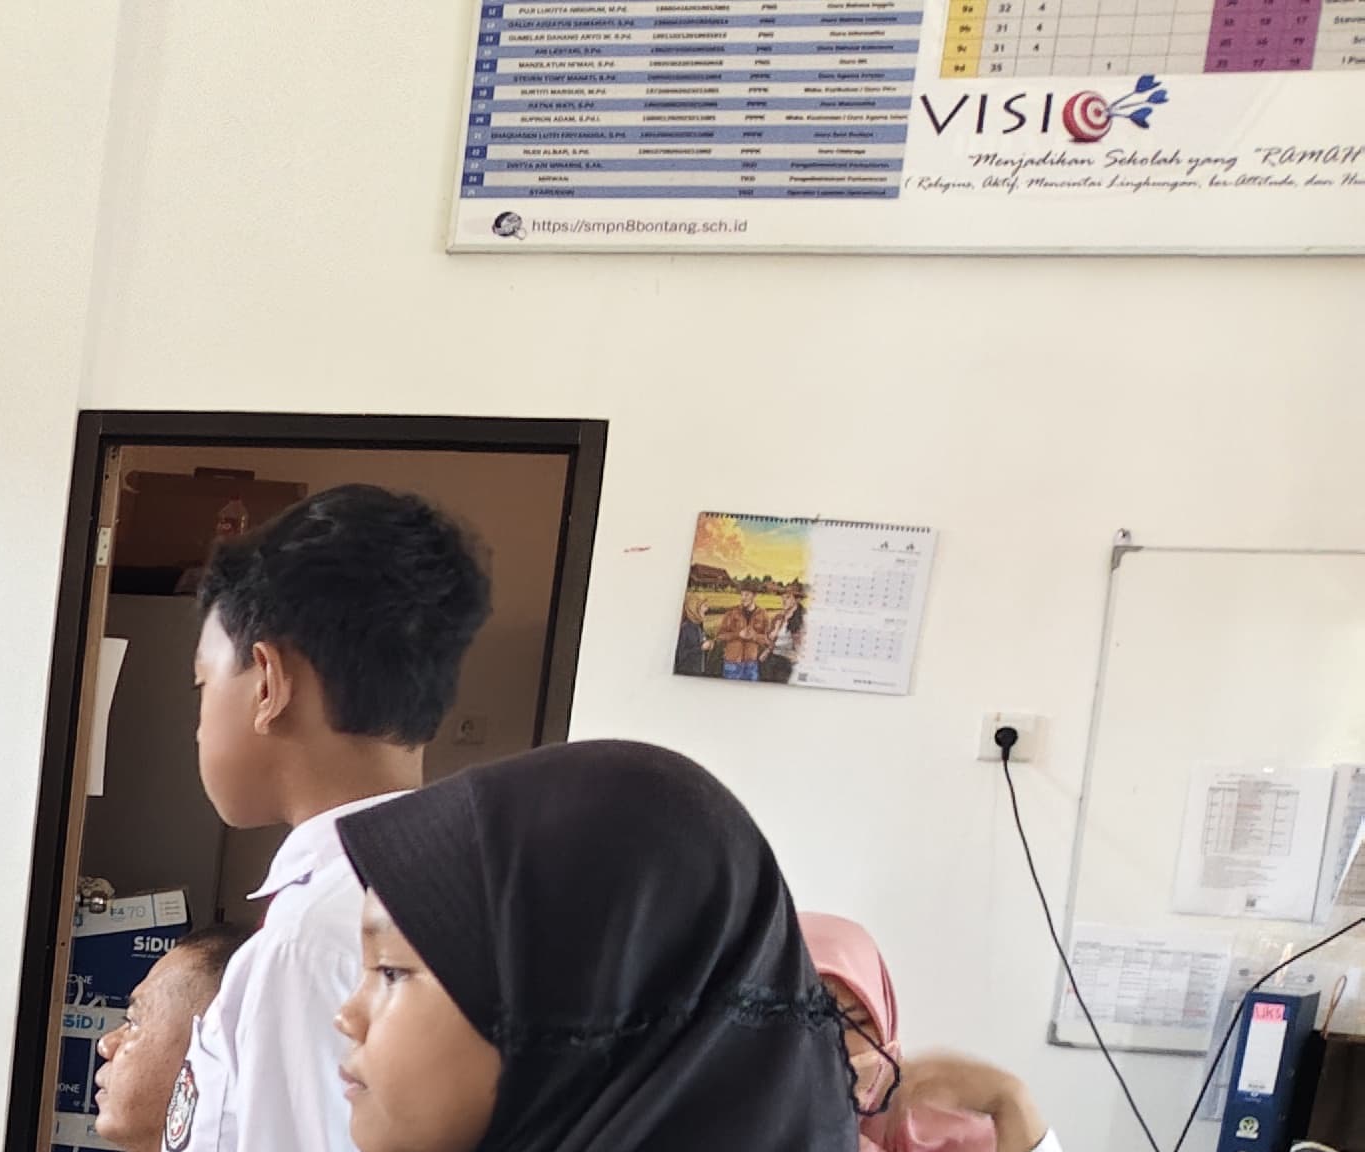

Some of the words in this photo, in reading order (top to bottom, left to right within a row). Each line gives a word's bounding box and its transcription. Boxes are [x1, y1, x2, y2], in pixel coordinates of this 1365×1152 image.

[920, 92, 1054, 136] VISI
[1104, 148, 1183, 167] Sekolah
[1187, 155, 1239, 176] yang
[531, 218, 749, 235] https://smpn8bontang.sch.id
